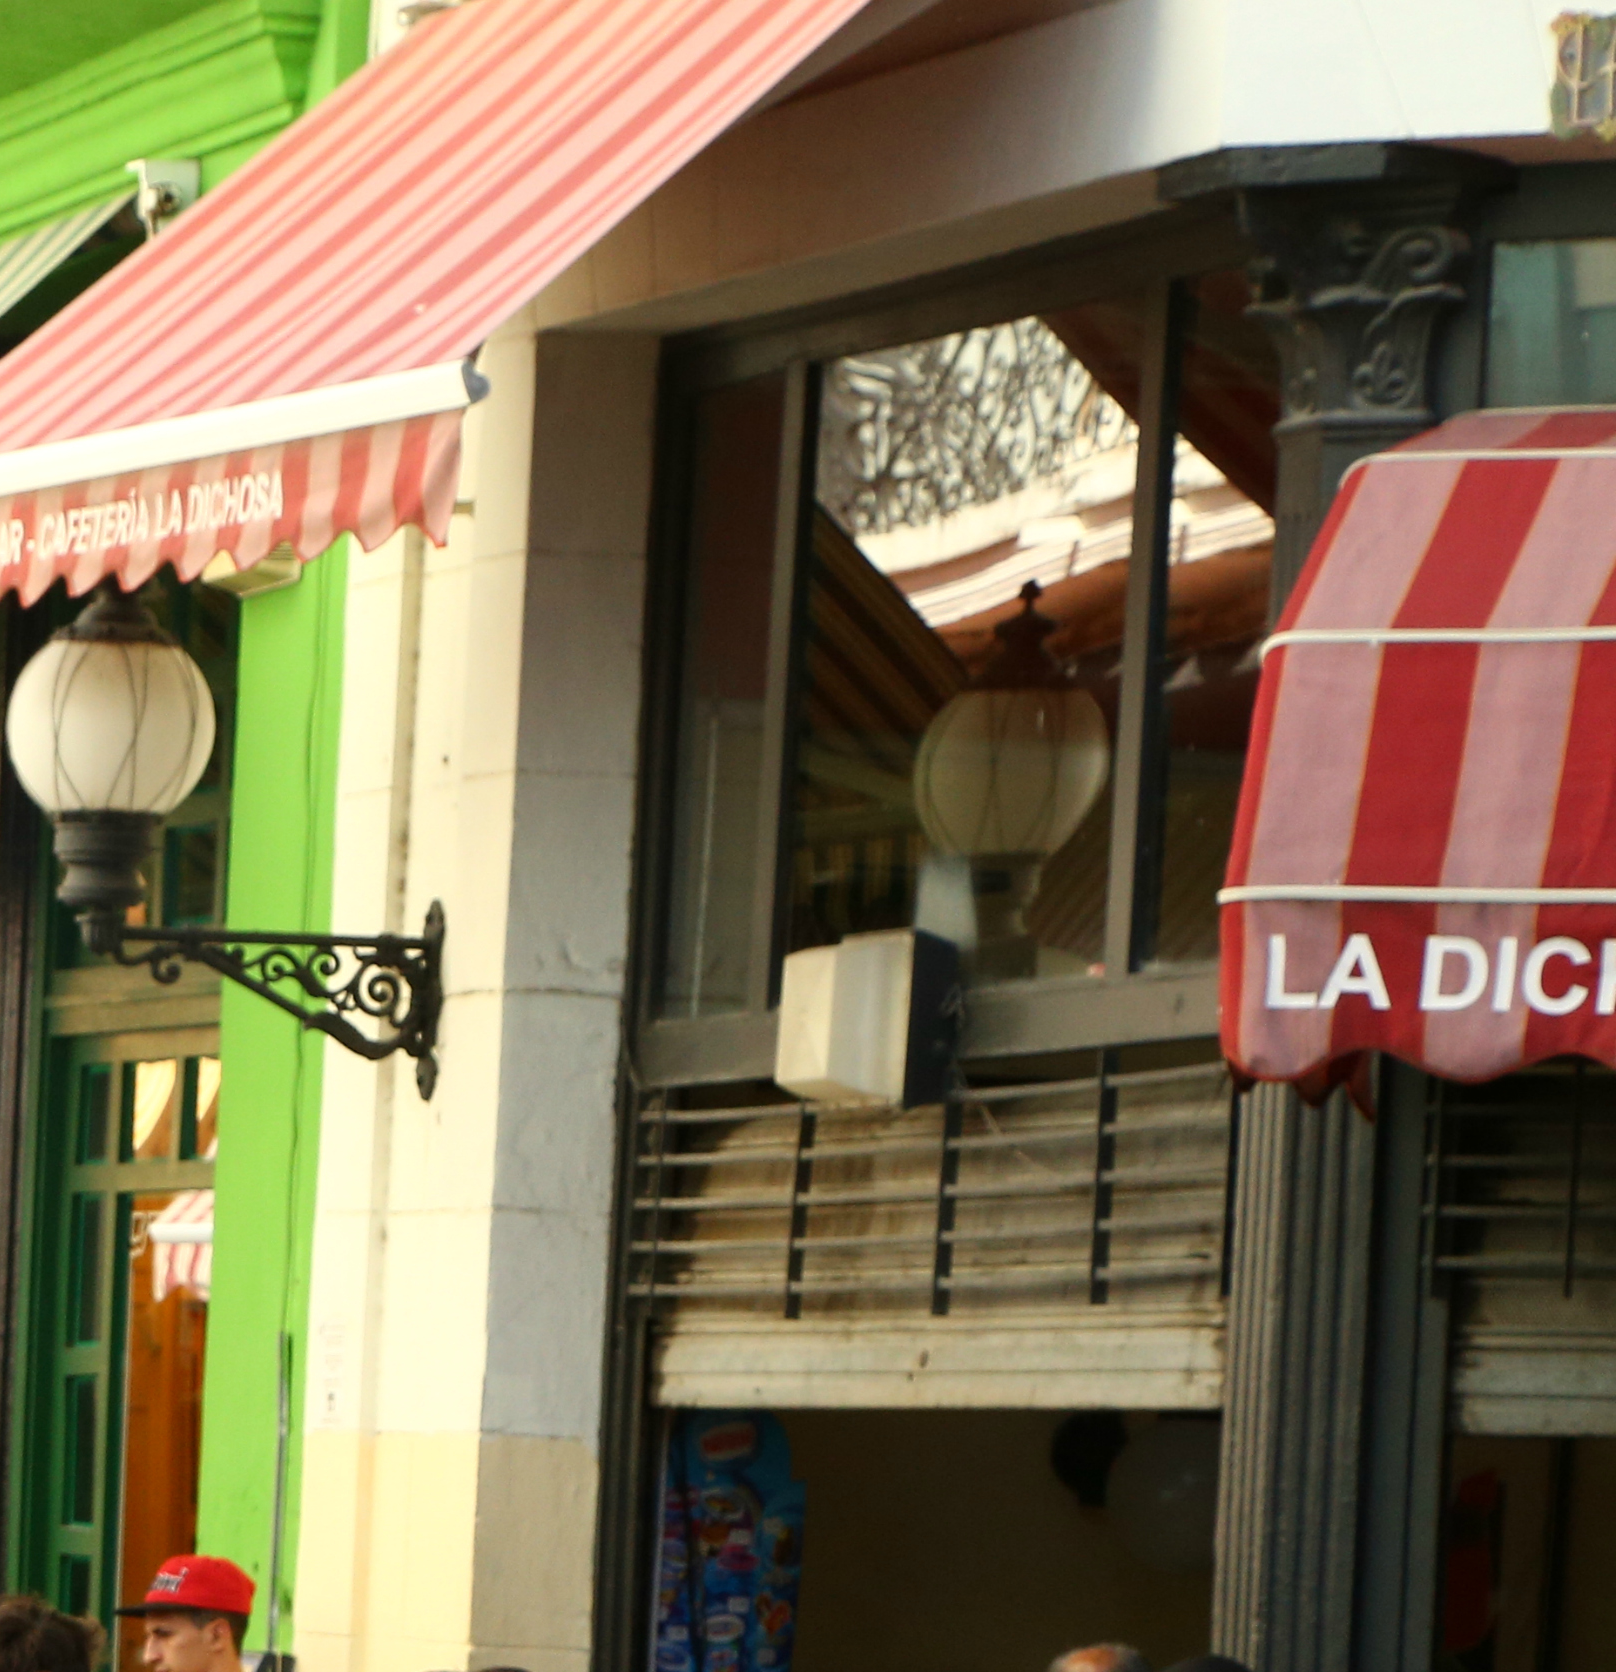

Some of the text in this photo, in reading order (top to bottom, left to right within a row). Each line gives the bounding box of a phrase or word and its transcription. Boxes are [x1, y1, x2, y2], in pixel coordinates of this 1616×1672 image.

[37, 489, 149, 560] CAFETERÍA
[156, 493, 183, 537] LA
[187, 471, 284, 532] DICHOSA
[1264, 932, 1391, 1010] LA
